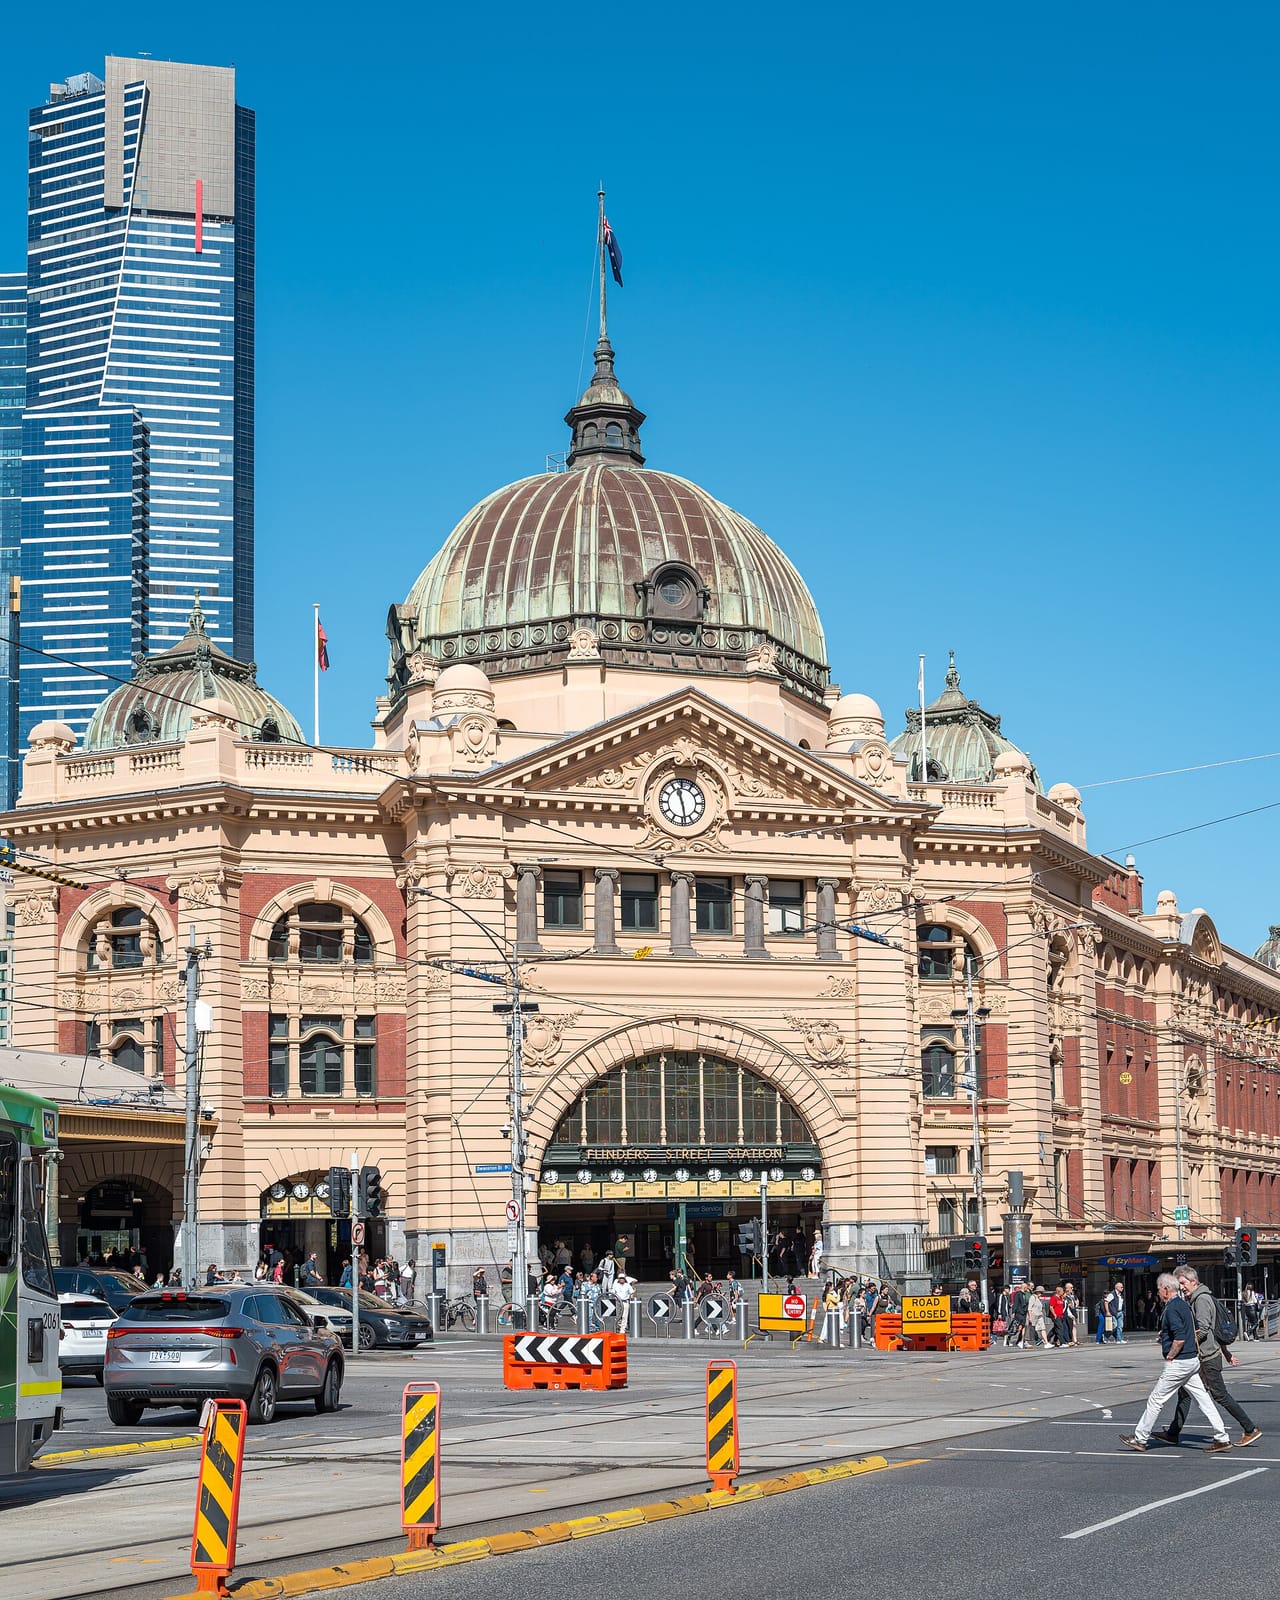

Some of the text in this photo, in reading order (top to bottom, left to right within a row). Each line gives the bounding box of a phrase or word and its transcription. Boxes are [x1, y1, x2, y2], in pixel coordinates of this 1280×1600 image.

[587, 1149, 782, 1160] FLINDERS STREET STATION
[912, 1298, 941, 1307] ROAD
[906, 1310, 947, 1319] CLOSED
[43, 1312, 60, 1329] 2061
